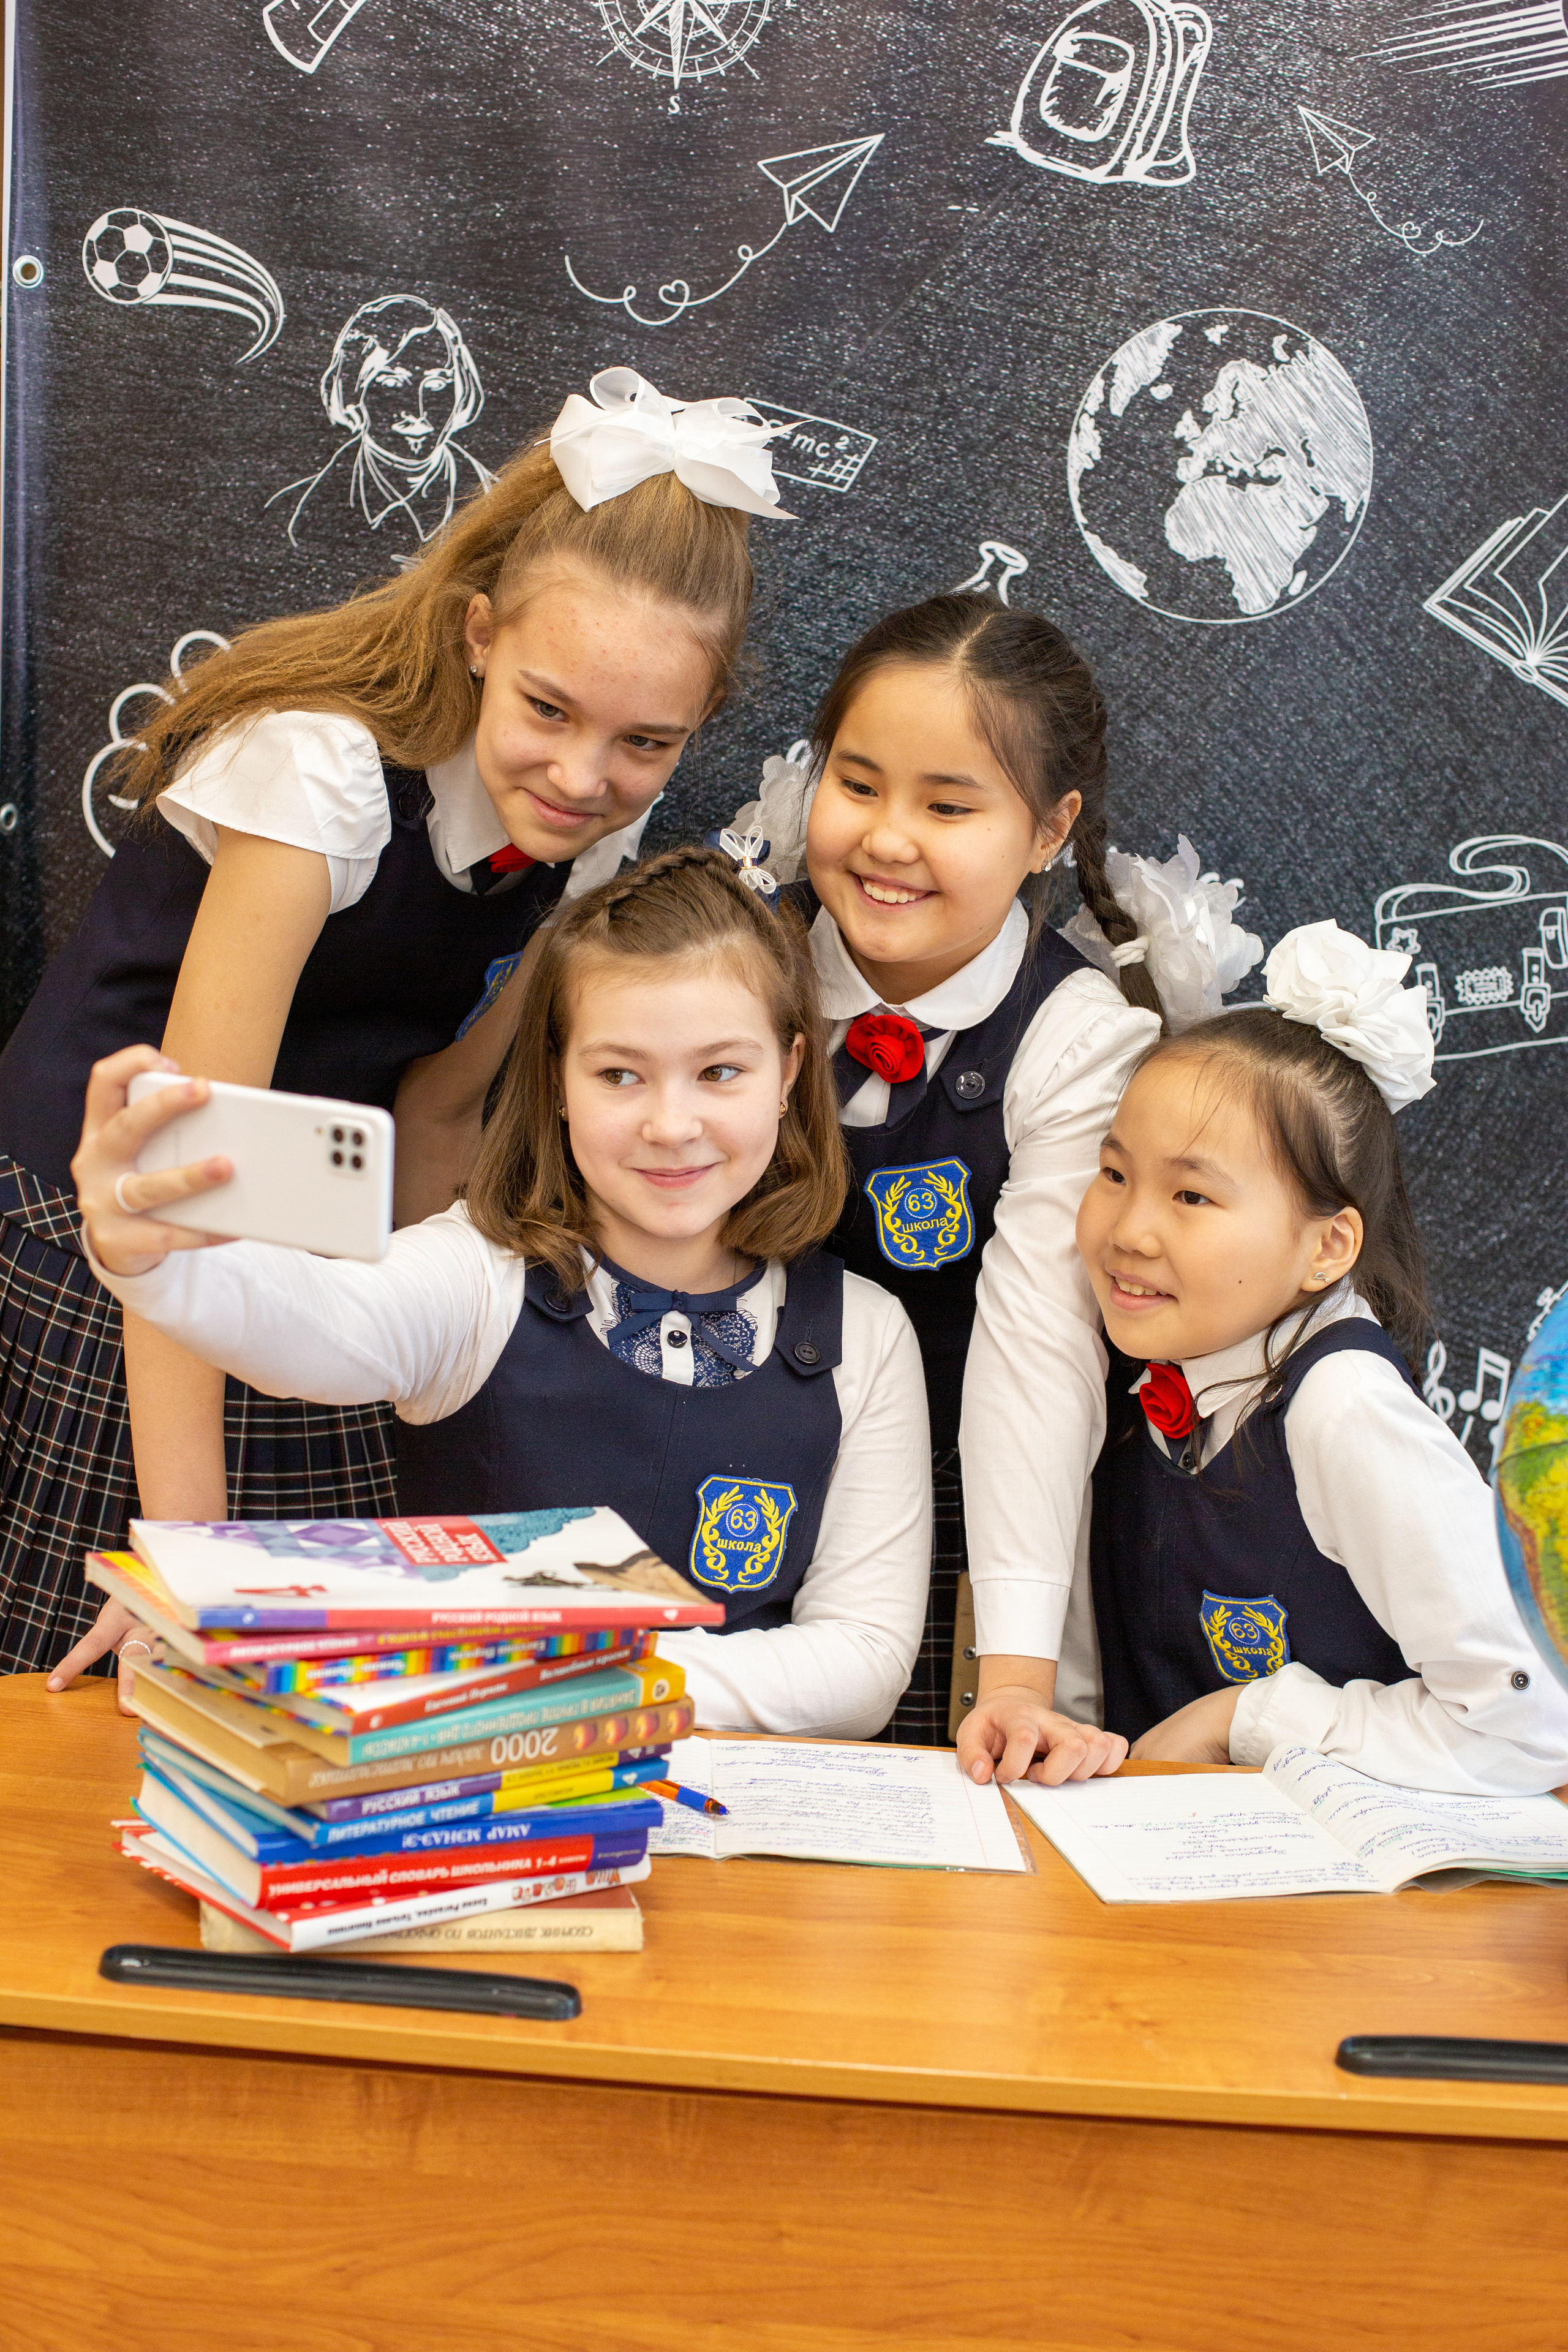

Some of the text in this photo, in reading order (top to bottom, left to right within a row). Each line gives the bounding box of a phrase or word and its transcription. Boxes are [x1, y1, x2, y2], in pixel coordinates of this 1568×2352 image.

[667, 96, 681, 115] S
[908, 1192, 934, 1212] 63
[902, 1217, 949, 1233] школа
[730, 1509, 756, 1531] 63
[717, 1538, 761, 1553] школа
[431, 1610, 563, 1624] РУССКИЙ РОДНОЙ ЯЗЫК
[1231, 1623, 1257, 1639] 63
[1232, 1646, 1275, 1657] школа
[579, 1698, 589, 1714] В
[490, 1726, 559, 1766] 2000
[361, 1783, 461, 1815] РУССКИЙ ЯЗЫК
[327, 1800, 480, 1844] ЛИТЕРАТУРНОЕ ЧТЕНИЕ
[487, 1823, 531, 1841] АМАР
[268, 1868, 388, 1898] УНИВЕРСАЛЬНЫЙ
[389, 1866, 450, 1884] СЛОВАРЬ
[450, 1857, 532, 1877] ШКОЛЬНИКА
[540, 1926, 594, 1939] СБОРНИК
